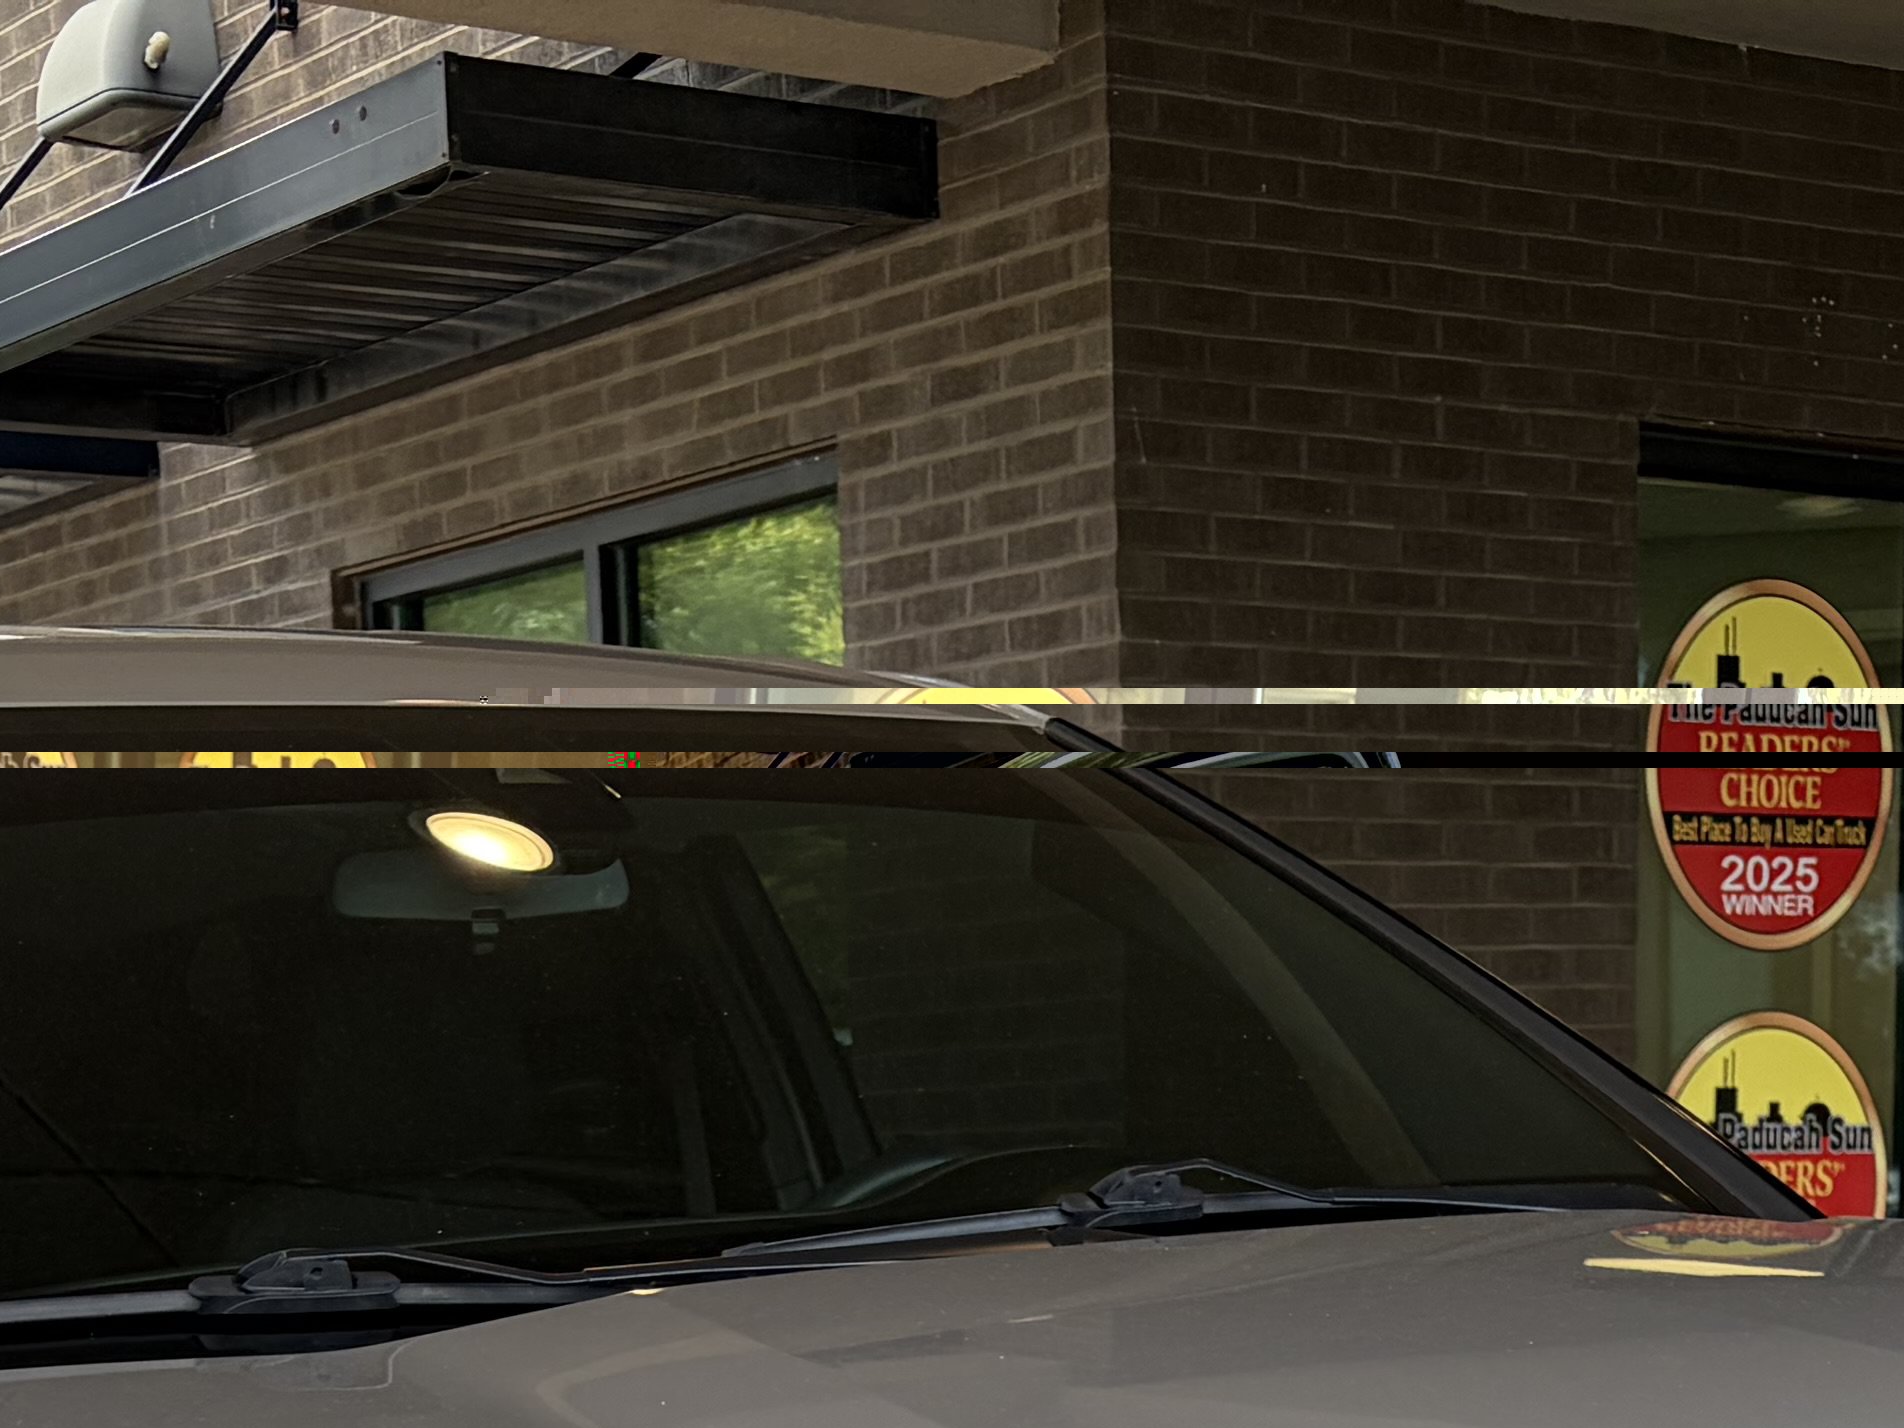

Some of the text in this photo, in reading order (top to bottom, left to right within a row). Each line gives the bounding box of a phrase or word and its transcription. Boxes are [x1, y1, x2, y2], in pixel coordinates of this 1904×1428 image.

[1720, 772, 1822, 810] CHOICE
[1673, 814, 1698, 842] Best
[1701, 815, 1732, 843] Place
[1734, 816, 1748, 843] To
[1750, 817, 1772, 849] Buy
[1774, 818, 1784, 844] A
[1785, 818, 1813, 844] Used
[1720, 855, 1819, 893] 2025
[1721, 894, 1814, 917] WINNER
[1718, 1113, 1873, 1154] Paducah Sun
